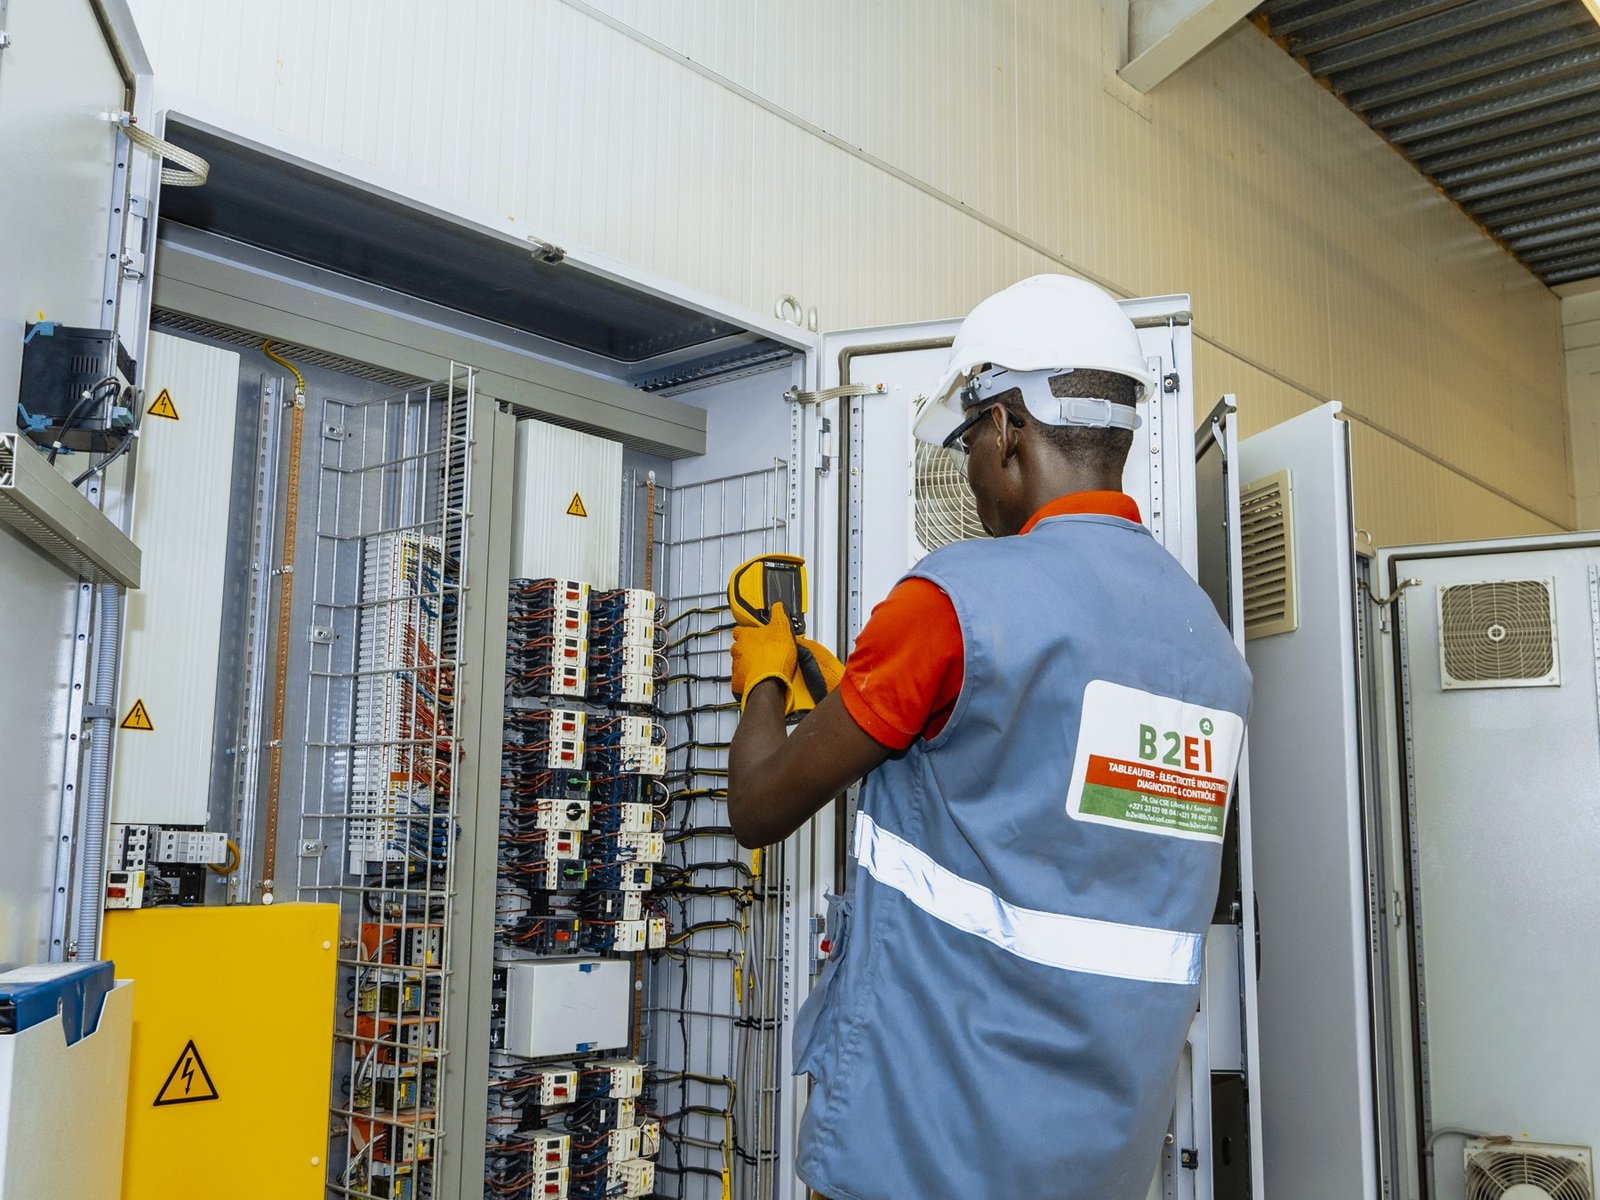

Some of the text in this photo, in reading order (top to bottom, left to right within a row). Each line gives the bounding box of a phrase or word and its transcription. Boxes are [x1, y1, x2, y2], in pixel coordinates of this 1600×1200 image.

[1109, 762, 1155, 779] TABLEAUTIER
[1159, 771, 1197, 787] ÉLECTRICITÉ
[1137, 779, 1216, 801] DIAGNOSTIC & CONTRÔLE
[1128, 803, 1143, 811] +221
[493, 973, 501, 981] L1
[491, 1004, 499, 1012] L2
